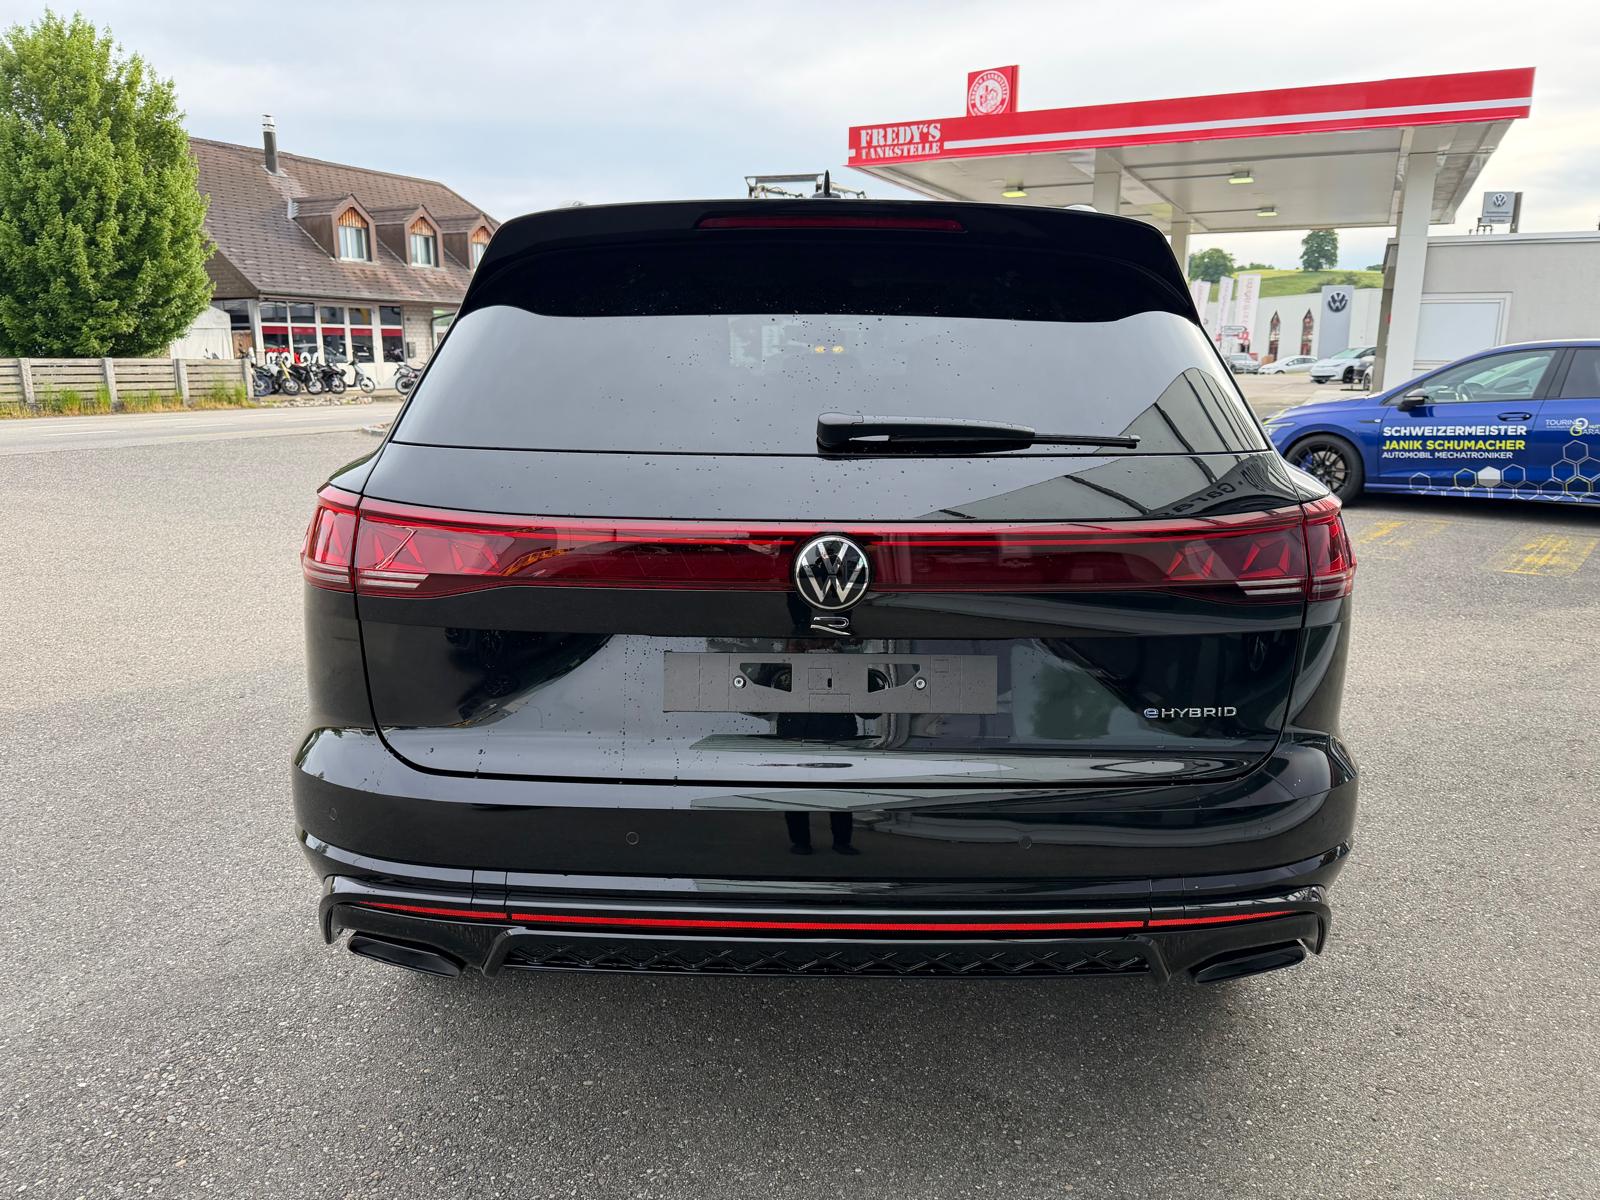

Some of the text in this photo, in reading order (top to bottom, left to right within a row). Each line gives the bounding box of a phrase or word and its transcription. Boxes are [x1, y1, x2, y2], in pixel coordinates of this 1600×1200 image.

[860, 123, 941, 147] FREDY'S
[861, 142, 941, 159] TANKSTELLE
[1382, 425, 1527, 437] SCHWEIZERMEISTER
[1381, 440, 1526, 450] JANIK SCHUMACHER
[1381, 451, 1514, 460] AUTOMOBIL MECHATRONIKER
